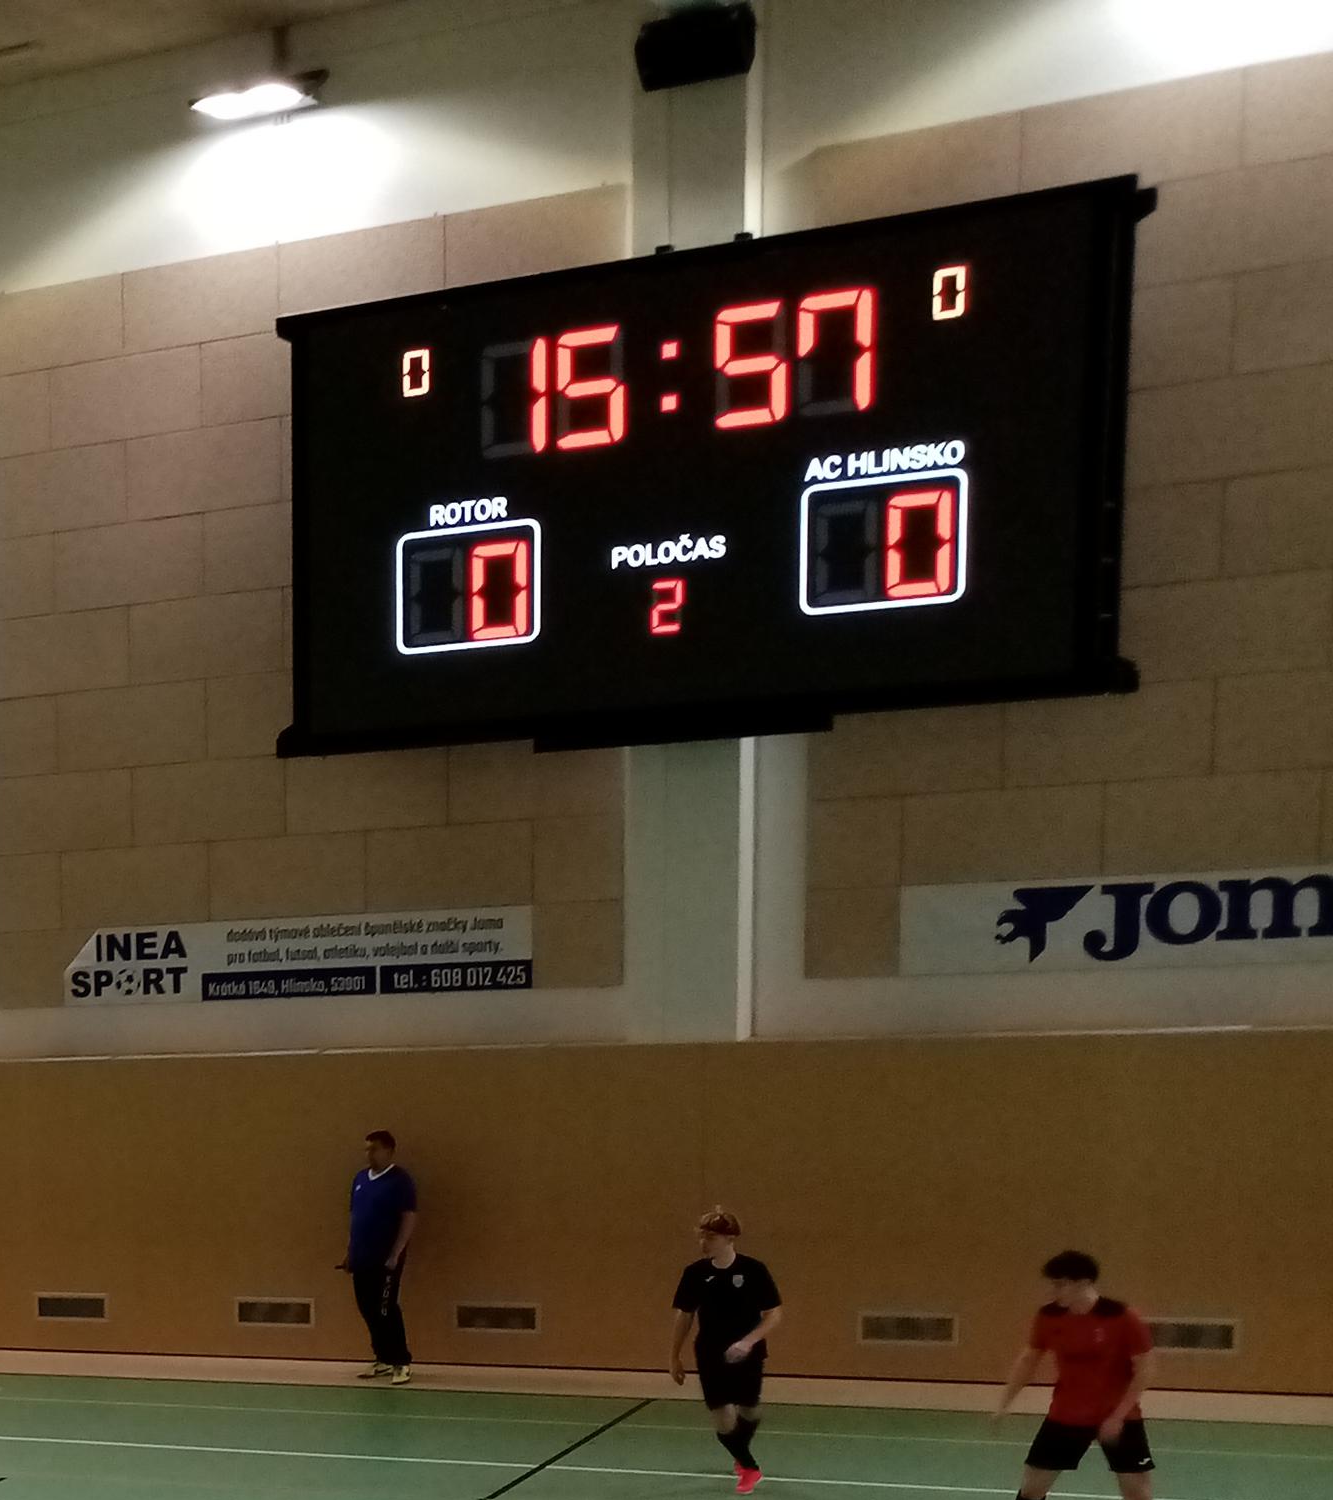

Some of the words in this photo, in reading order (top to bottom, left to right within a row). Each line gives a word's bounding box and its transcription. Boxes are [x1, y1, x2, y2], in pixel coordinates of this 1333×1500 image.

[931, 264, 967, 321] 0
[401, 347, 431, 398] 0
[530, 287, 878, 454] 15:57
[805, 453, 843, 482] AC
[846, 439, 966, 478] HLINSKO
[429, 496, 509, 524] ROTOR
[611, 533, 727, 570] POLOČAS
[885, 488, 956, 600] 0
[467, 539, 529, 642] 0
[651, 577, 685, 635] 2
[95, 930, 187, 963] INEA
[426, 917, 469, 934] značky
[226, 952, 245, 967] pro
[430, 967, 462, 987] 608
[466, 966, 493, 987] 012
[496, 965, 527, 985] 425
